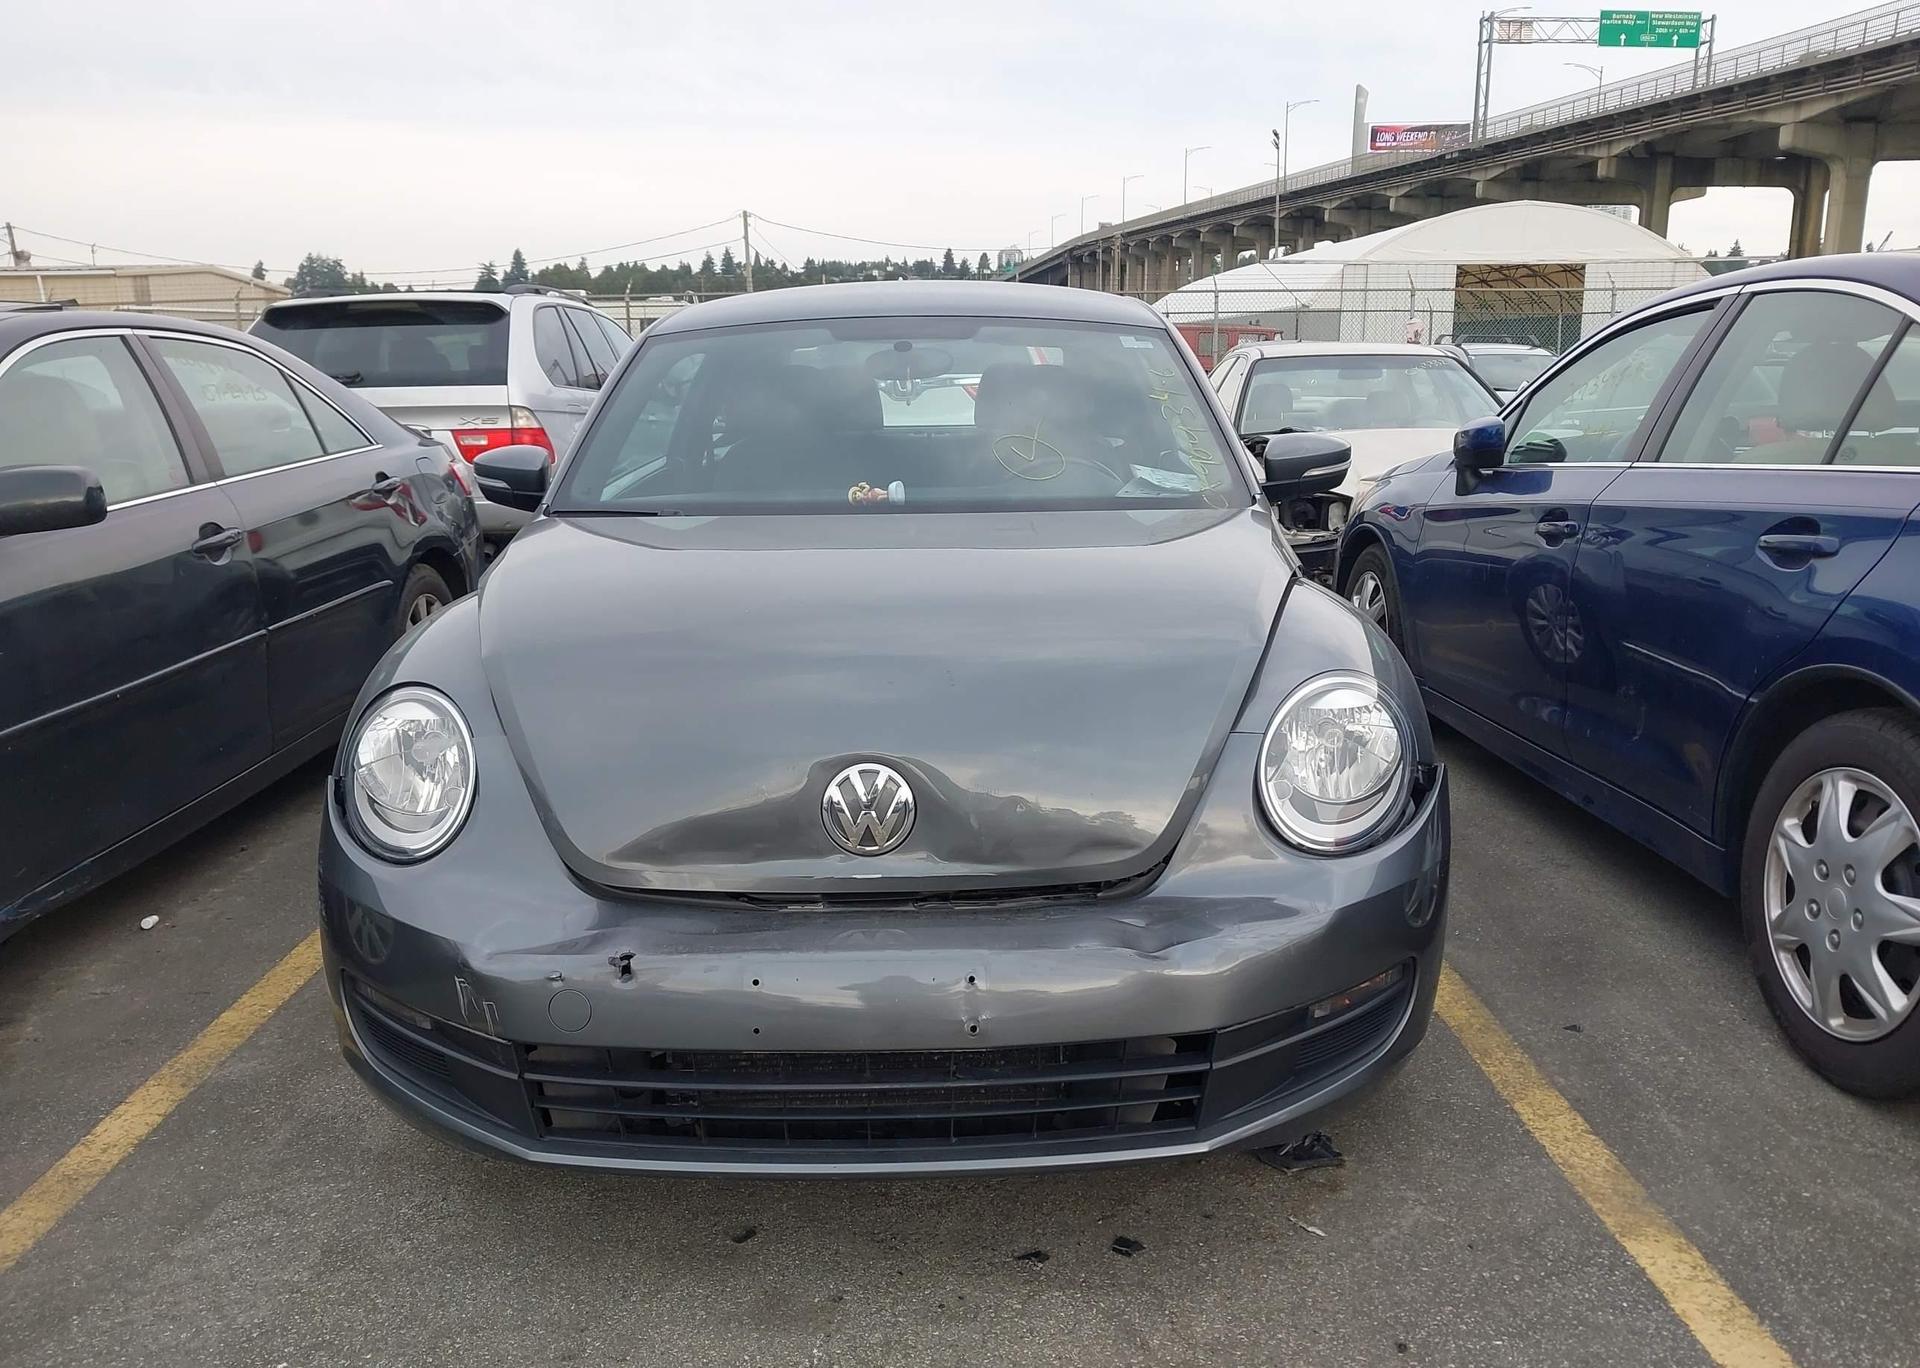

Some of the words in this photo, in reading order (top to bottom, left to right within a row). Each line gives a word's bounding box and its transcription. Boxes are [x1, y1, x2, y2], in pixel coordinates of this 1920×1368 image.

[1376, 131, 1395, 142] LONG
[1396, 131, 1428, 142] WEEKEND
[458, 416, 499, 425] X5
[821, 763, 916, 856] VW
